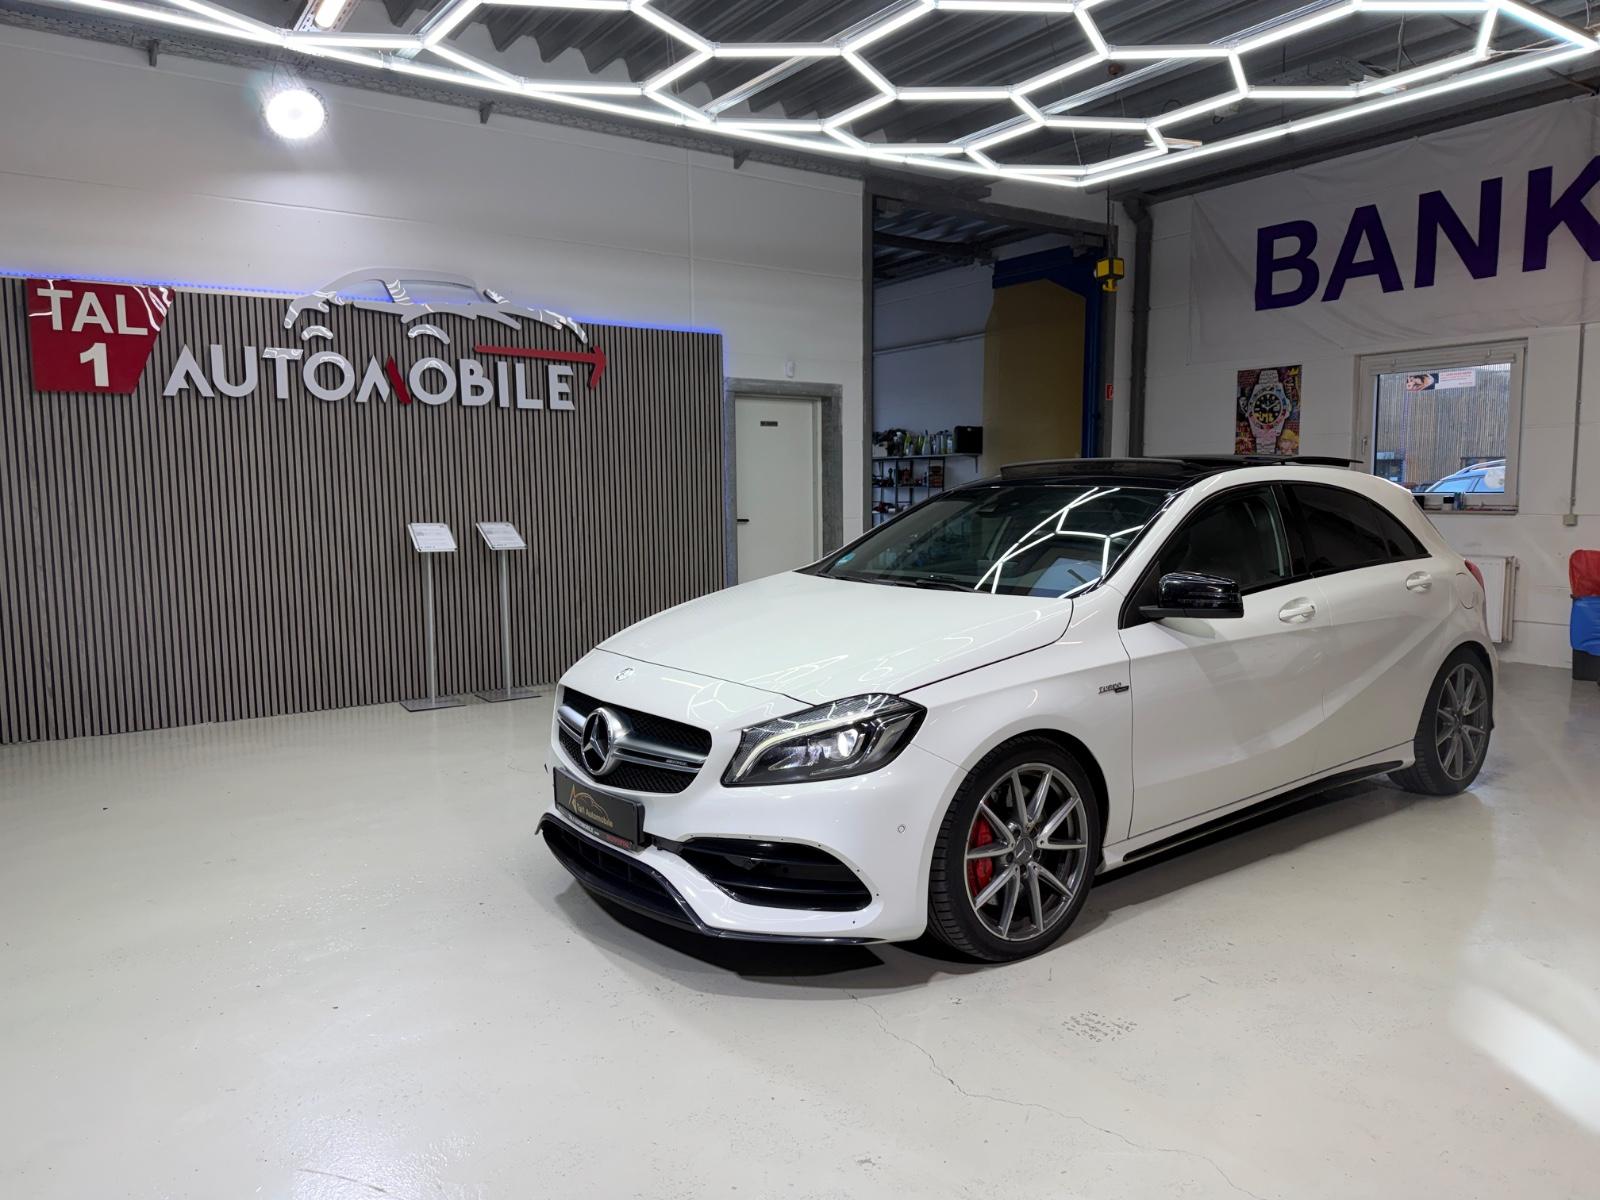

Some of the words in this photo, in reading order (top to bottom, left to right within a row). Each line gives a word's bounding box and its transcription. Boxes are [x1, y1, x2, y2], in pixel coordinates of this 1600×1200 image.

[1255, 155, 1600, 311] BANK
[37, 288, 148, 336] TAL
[79, 342, 110, 387] 1
[163, 344, 576, 411] AUTOMOBILE
